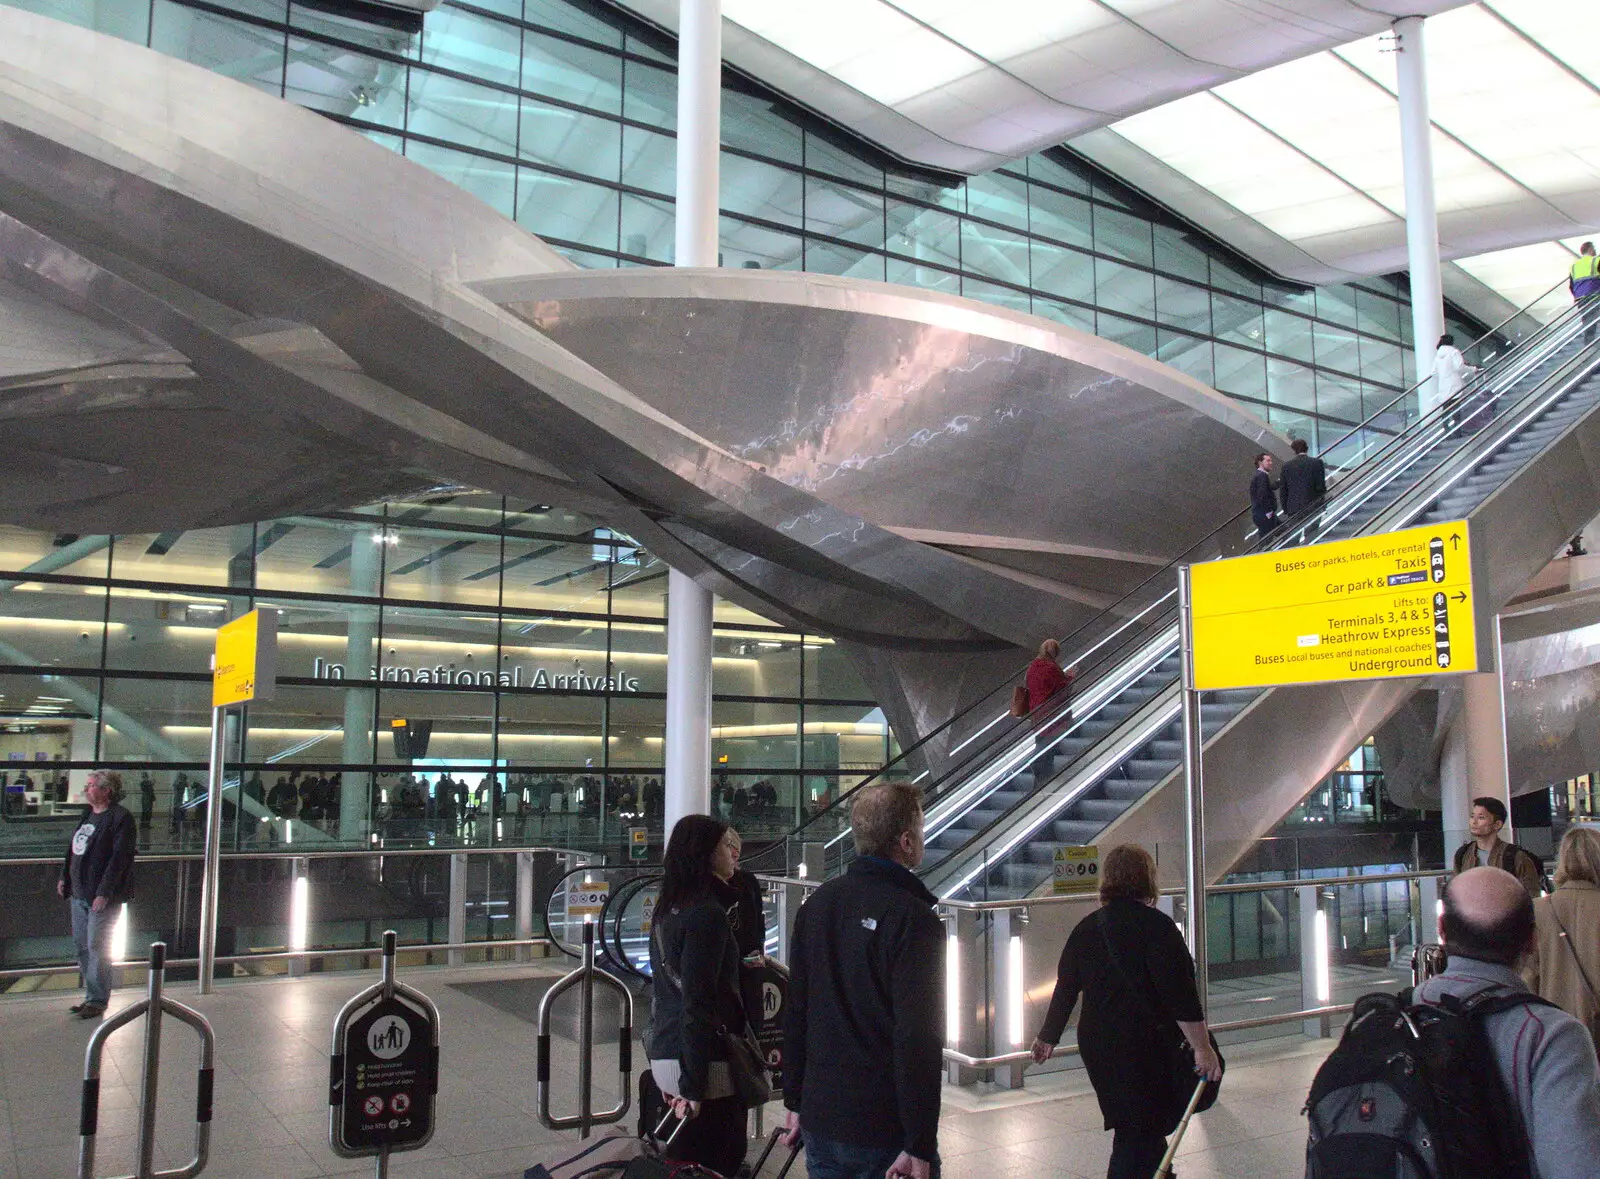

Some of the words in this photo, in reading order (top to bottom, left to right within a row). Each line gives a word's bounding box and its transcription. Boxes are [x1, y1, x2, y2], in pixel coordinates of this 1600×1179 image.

[1275, 560, 1306, 573] Buses
[1323, 556, 1348, 568] parks,
[1350, 550, 1380, 562] hotels,
[1382, 548, 1396, 556] car
[1398, 542, 1426, 554] rental
[1395, 556, 1427, 570] Taxis
[1326, 582, 1344, 594] Car
[1348, 577, 1374, 594] park
[1376, 576, 1385, 588] &
[1394, 598, 1413, 608] Lifts
[1416, 596, 1429, 606] to:
[1328, 613, 1385, 630] Terminals
[1388, 612, 1398, 624] 3,
[1400, 610, 1408, 621] 4
[1411, 610, 1419, 620] &
[1423, 608, 1430, 619] 5
[1321, 630, 1380, 645] Heathrow
[1383, 624, 1431, 640] Express
[1255, 654, 1285, 665] Buses
[1310, 650, 1334, 660] buses
[1336, 648, 1352, 658] and
[1354, 645, 1392, 656] national
[1394, 642, 1432, 653] coaches
[1349, 655, 1432, 672] Underground
[314, 657, 522, 688] Inrnational
[530, 667, 640, 693] Arrivals
